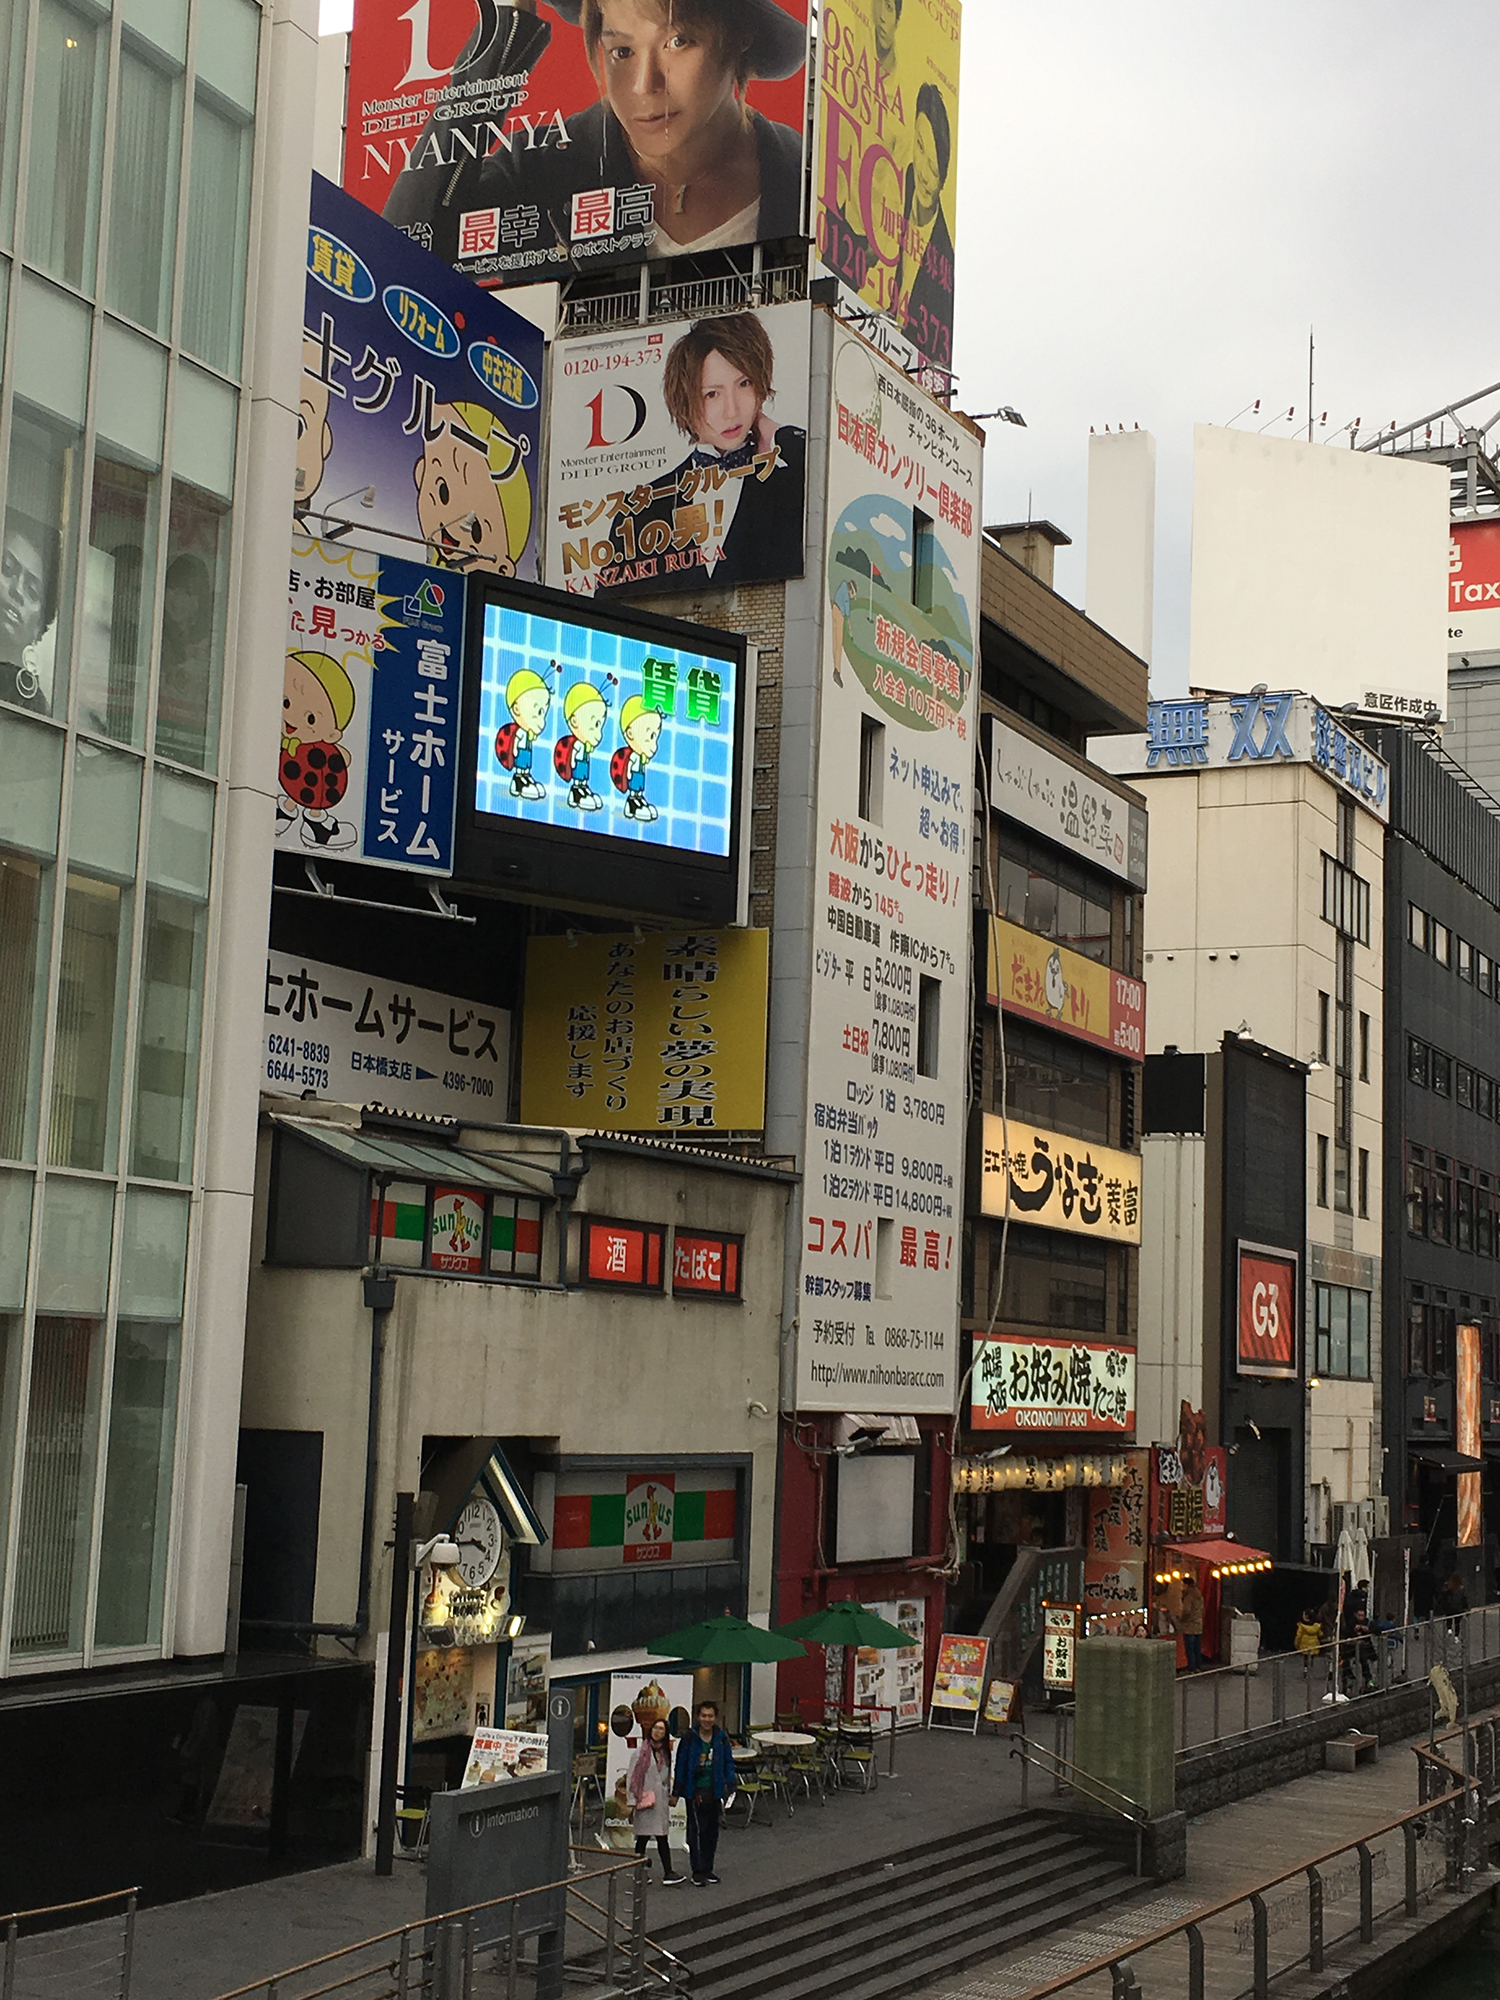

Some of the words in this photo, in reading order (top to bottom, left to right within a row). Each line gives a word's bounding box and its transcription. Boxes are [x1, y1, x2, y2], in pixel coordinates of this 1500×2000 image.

[823, 7, 905, 127] OSAKA
[362, 91, 421, 117] Monster
[424, 70, 528, 103] Entertainment
[362, 108, 430, 135] DEEP
[433, 92, 529, 121] GROUP
[821, 41, 889, 141] HOST
[361, 109, 573, 180] NYANNYA
[818, 88, 904, 267] FC
[571, 184, 656, 237] 最高
[311, 232, 356, 296] 賃貸
[571, 231, 657, 257] のホストクラブ
[816, 211, 951, 364] 0120-194-373
[398, 292, 447, 352] リフォーム
[482, 348, 524, 402] 中古流通
[563, 348, 662, 376] 0120-194-373
[303, 311, 532, 485] 士グループ
[560, 453, 599, 468] Monster
[600, 445, 667, 463] Entertainment
[561, 467, 603, 482] DEEP
[606, 458, 668, 476] GROUP
[837, 403, 973, 539] 日本原カンツリー倶楽部
[907, 422, 974, 487] チャンピオンコース
[558, 446, 781, 530] モンスターグループ
[564, 557, 658, 594] KANZAKI
[665, 545, 728, 573] RUKA
[1451, 580, 1500, 604] Tax
[640, 656, 722, 725] 賃貸
[1364, 692, 1438, 716] 意匠作成中
[406, 638, 451, 860] 富士ホーム
[377, 728, 405, 845] サービス
[889, 747, 964, 813] ネット申込みで、
[827, 905, 881, 949] 中国自動車道
[875, 957, 912, 996] 5,200円
[1116, 977, 1141, 1012] 17:00
[268, 1034, 330, 1064] 6241-8839
[602, 941, 636, 1112] あなたのお店づくり
[656, 935, 720, 1128] 素晴らしい夢の実現
[842, 1023, 869, 1056] 土日祝
[872, 1018, 911, 1058] 7,800円
[267, 1060, 329, 1089] 6644-5573
[351, 1052, 413, 1081] 日本橋支店
[442, 1071, 494, 1098] 4396-7000
[565, 1005, 598, 1100] 応援します
[847, 1081, 874, 1106] ロッジ
[880, 1088, 896, 1113] 1泊
[903, 1096, 945, 1126] 3,780円
[1010, 1136, 1103, 1225] うなぎ
[440, 1255, 470, 1271] サンクス
[606, 1236, 627, 1274] 酒
[674, 1246, 722, 1282] たばこ
[807, 1216, 872, 1260] コスパ
[900, 1225, 953, 1271] 最高!
[805, 1274, 872, 1302] 幹部スタッフ募集
[1252, 1281, 1279, 1339] G3
[813, 1319, 855, 1346] 予約受付
[885, 1326, 944, 1350] 0868-75-1144
[811, 1360, 945, 1387] http://www.nihonbaracc.com
[1009, 1343, 1092, 1406] お好み焼
[986, 1380, 1009, 1418] 大阪
[1015, 1410, 1088, 1427] OKONOMIYAKI
[1092, 1377, 1127, 1427] たこ焼
[472, 1504, 480, 1518] 12
[1055, 1636, 1069, 1679] お好み焼
[474, 1738, 502, 1752] 営業中
[487, 1804, 539, 1829] information
